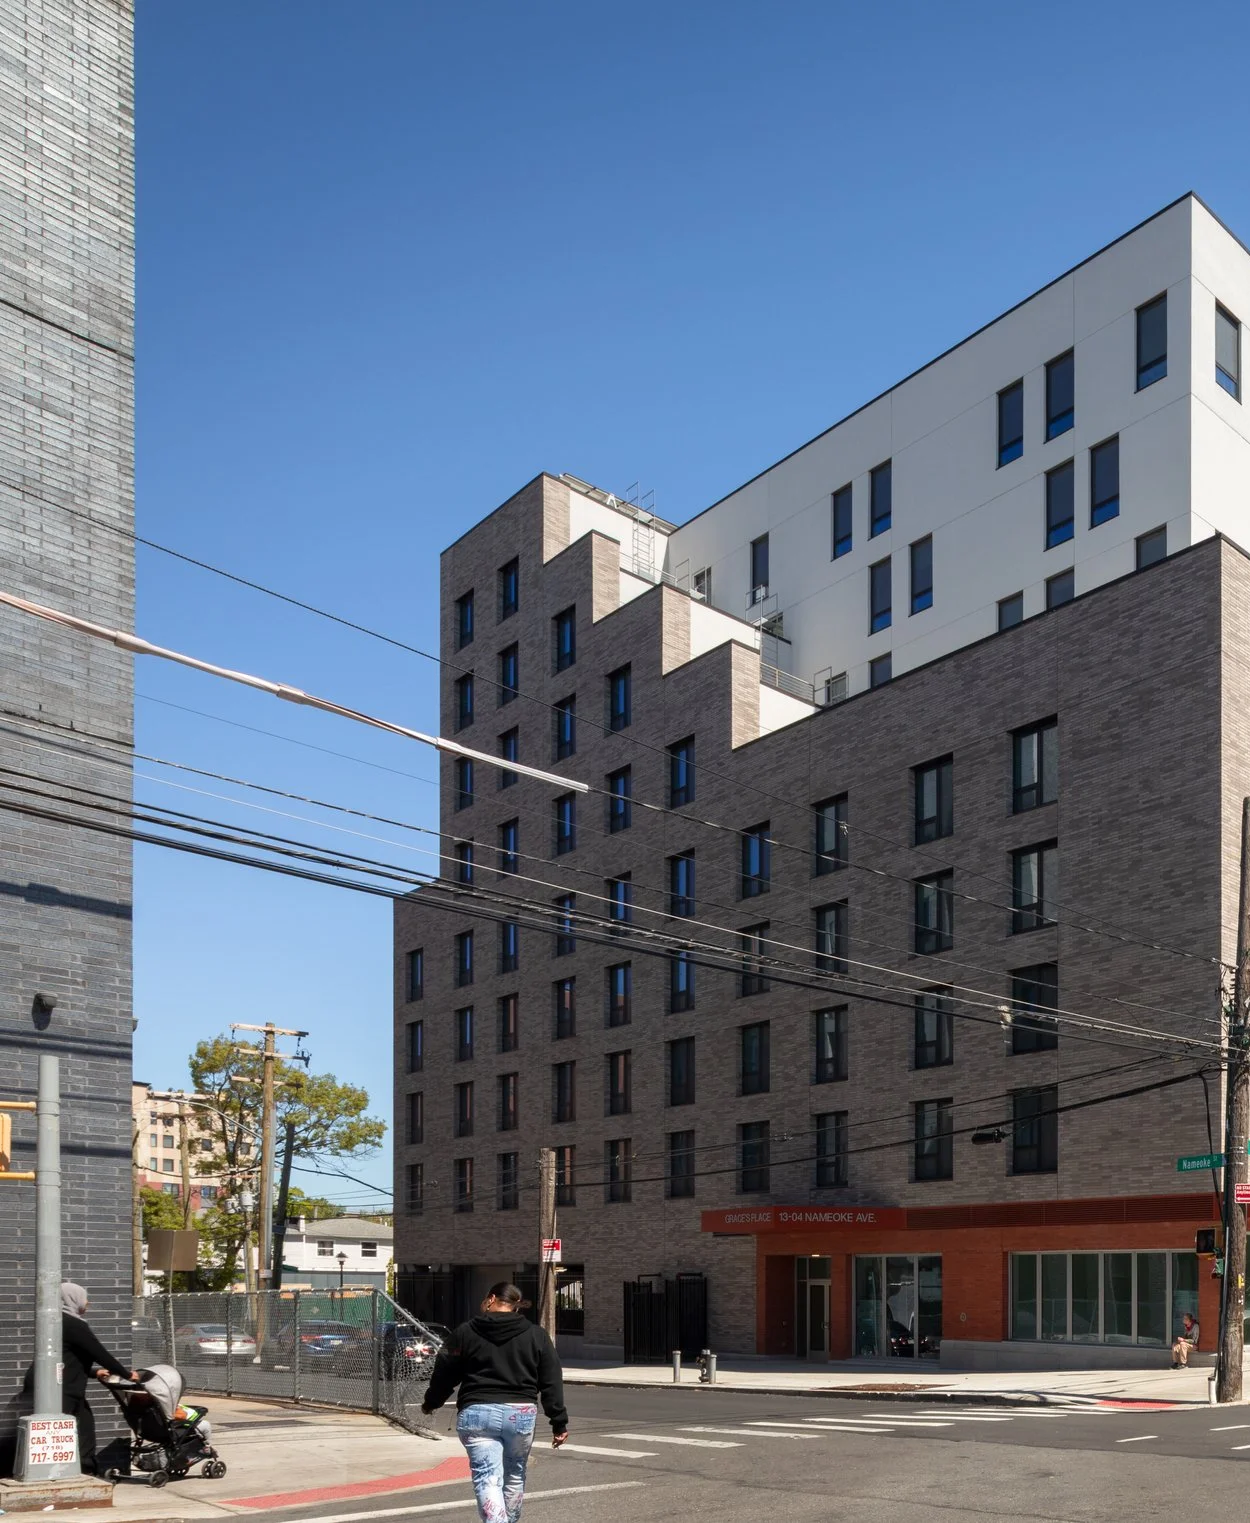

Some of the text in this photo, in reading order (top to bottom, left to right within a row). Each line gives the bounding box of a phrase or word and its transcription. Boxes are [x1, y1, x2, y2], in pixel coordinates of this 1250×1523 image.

[1182, 1158, 1211, 1169] Nameoke
[751, 1212, 772, 1222] PLACE
[779, 1213, 802, 1222] 13-04
[805, 1213, 853, 1222] NAMEOKE
[31, 1421, 74, 1430] BEST CASH
[31, 1435, 74, 1445] CAR TRUCK
